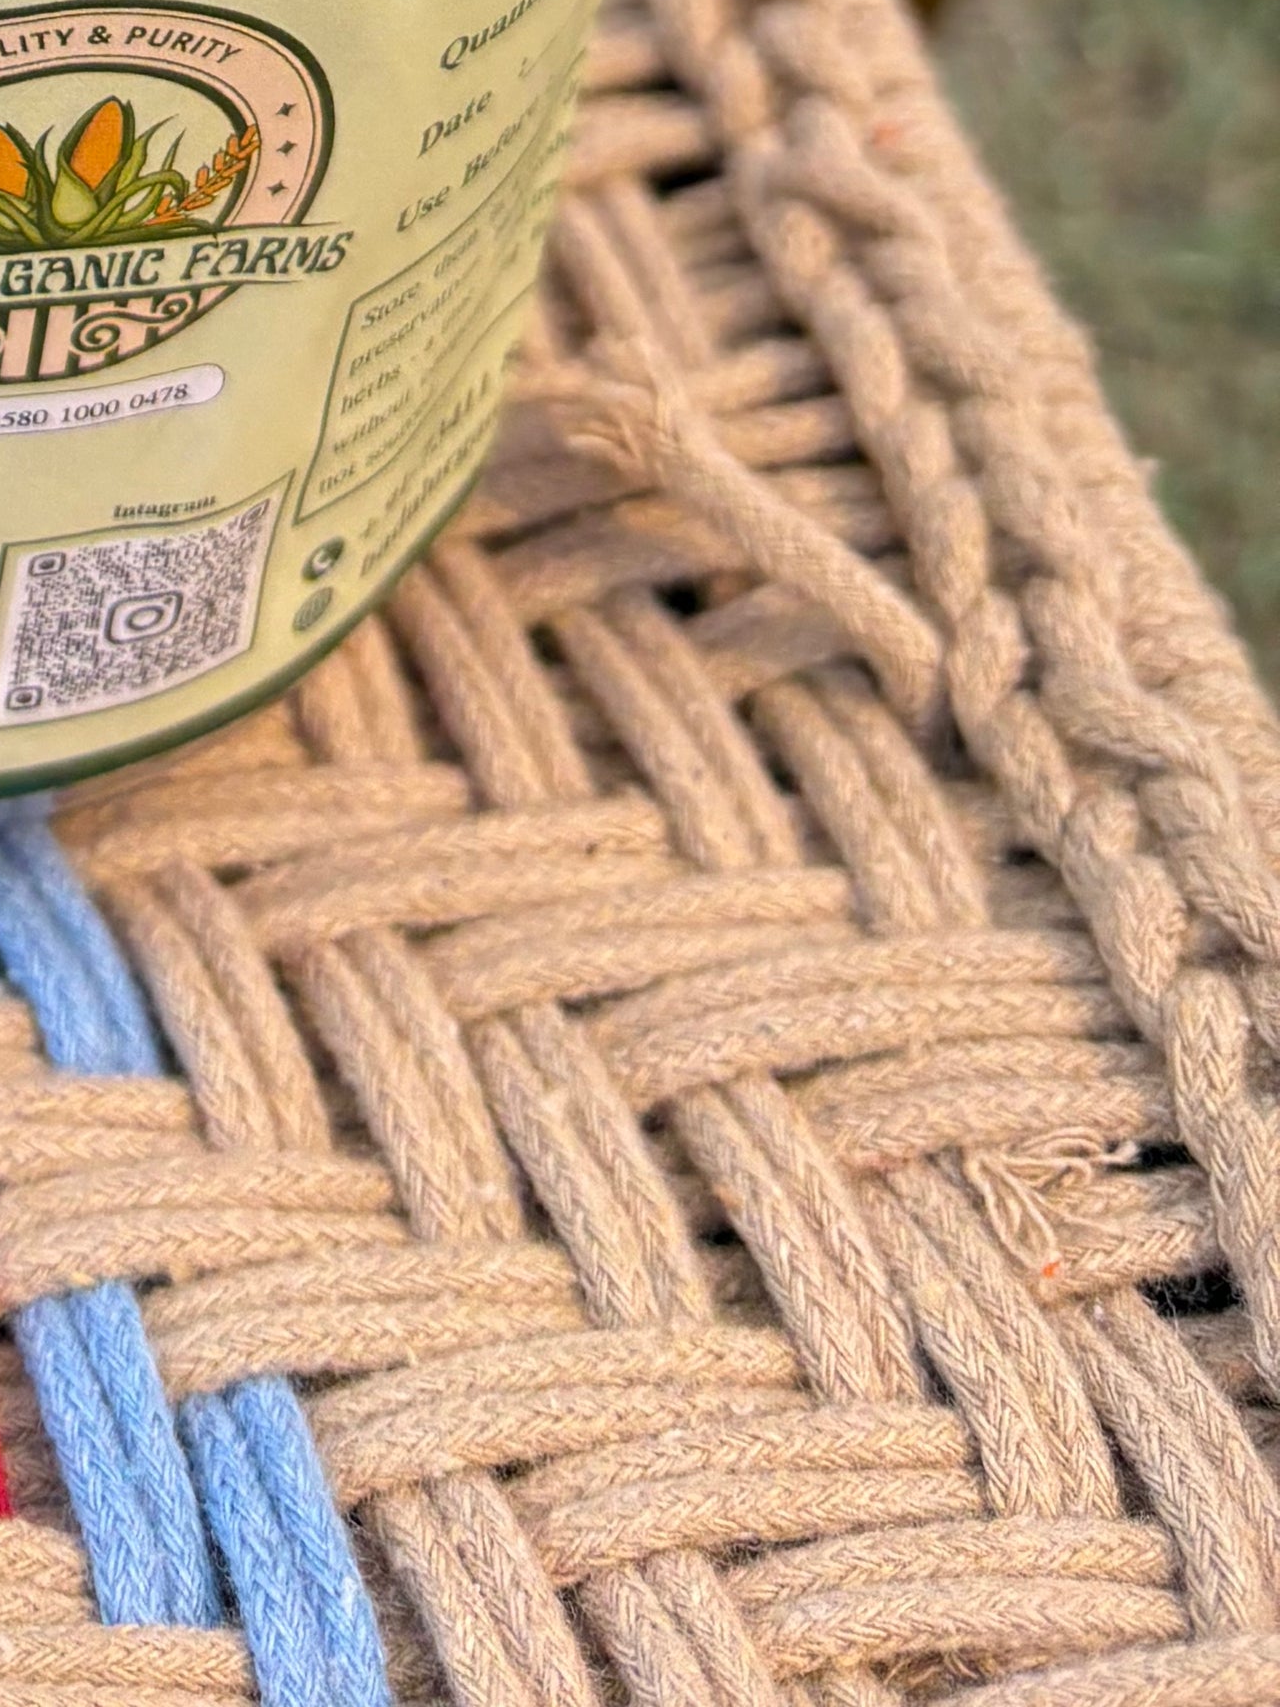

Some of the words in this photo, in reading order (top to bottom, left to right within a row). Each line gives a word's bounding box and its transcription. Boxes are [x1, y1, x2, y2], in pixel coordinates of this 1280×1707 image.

[88, 24, 113, 45] &
[125, 25, 243, 66] PURITY
[417, 90, 492, 158] Date
[397, 185, 450, 233] Use
[180, 229, 356, 280] FARMS
[60, 398, 120, 423] 1000
[129, 383, 189, 410] 0478
